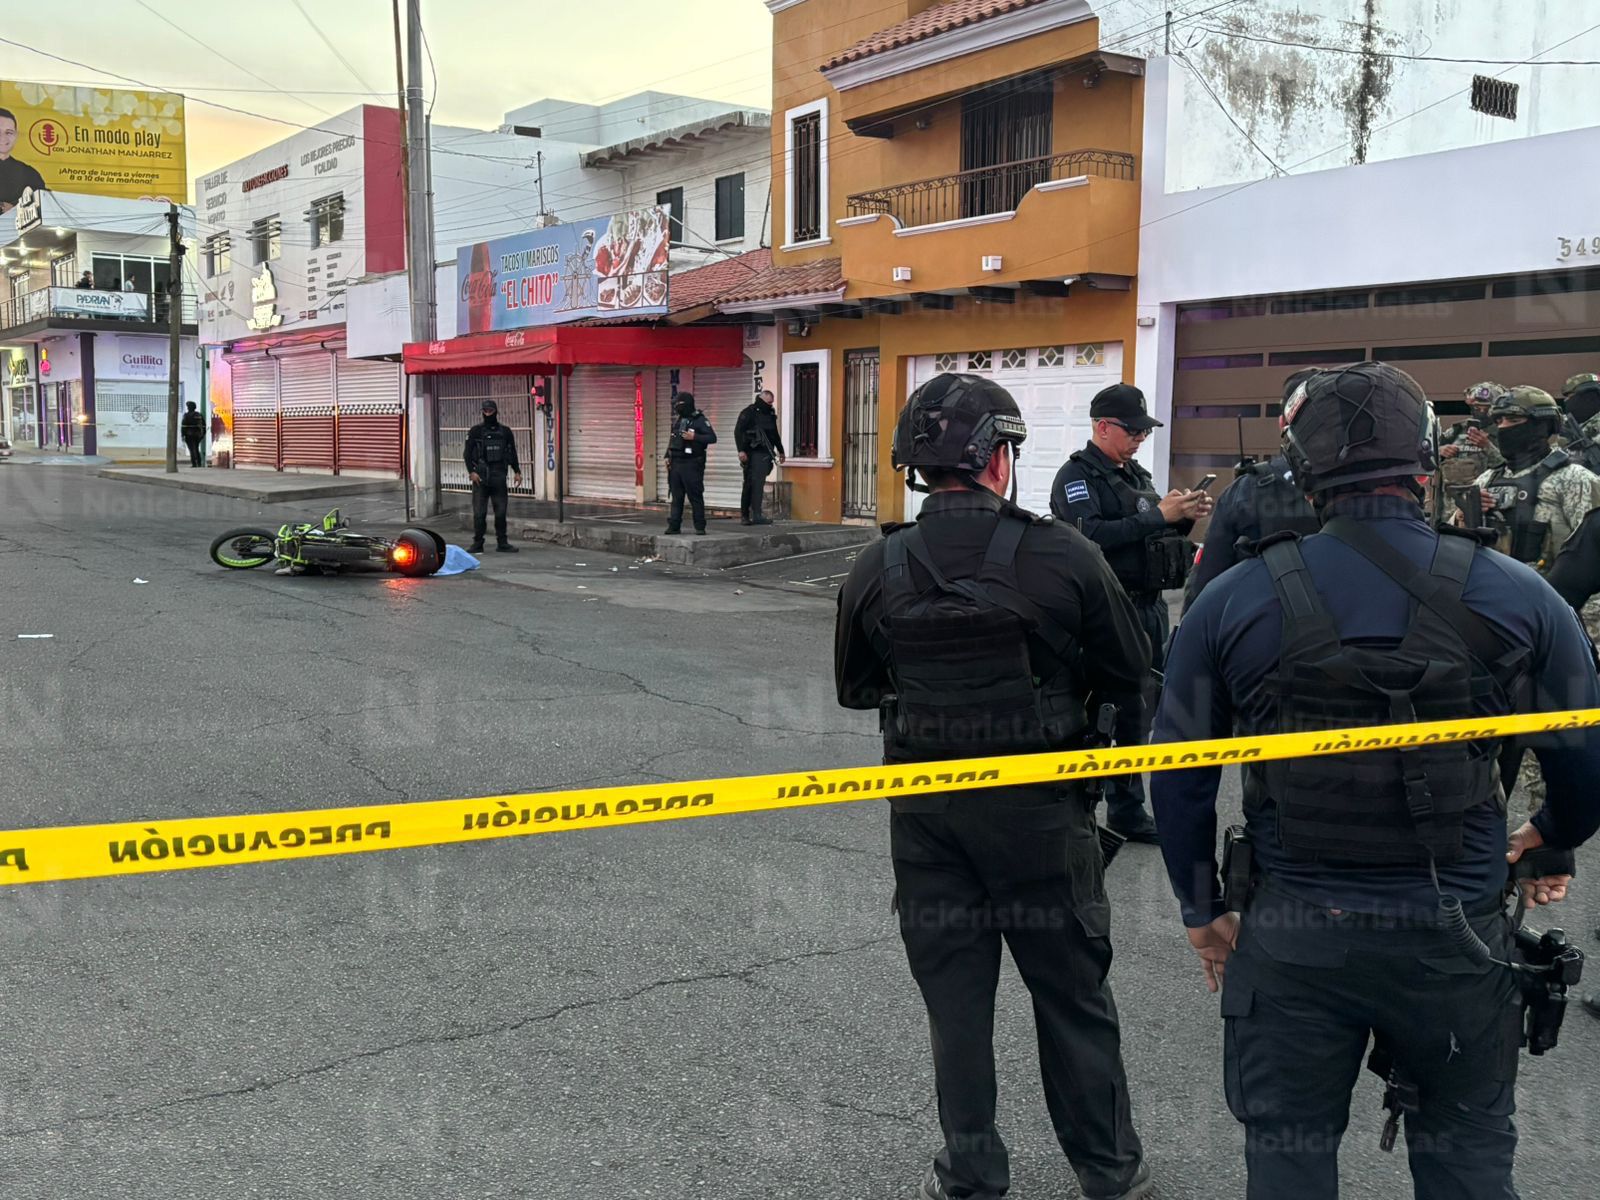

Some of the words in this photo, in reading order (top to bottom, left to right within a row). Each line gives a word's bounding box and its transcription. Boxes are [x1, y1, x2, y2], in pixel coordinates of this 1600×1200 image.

[75, 126, 89, 143] En
[94, 128, 130, 145] modo
[135, 129, 161, 148] play
[66, 146, 116, 156] JONATHAN
[118, 148, 173, 159] MANJARREZ
[100, 170, 122, 178] lunes
[131, 172, 160, 180] viernes
[501, 254, 521, 274] TACOS
[526, 245, 559, 269] MARISCOS
